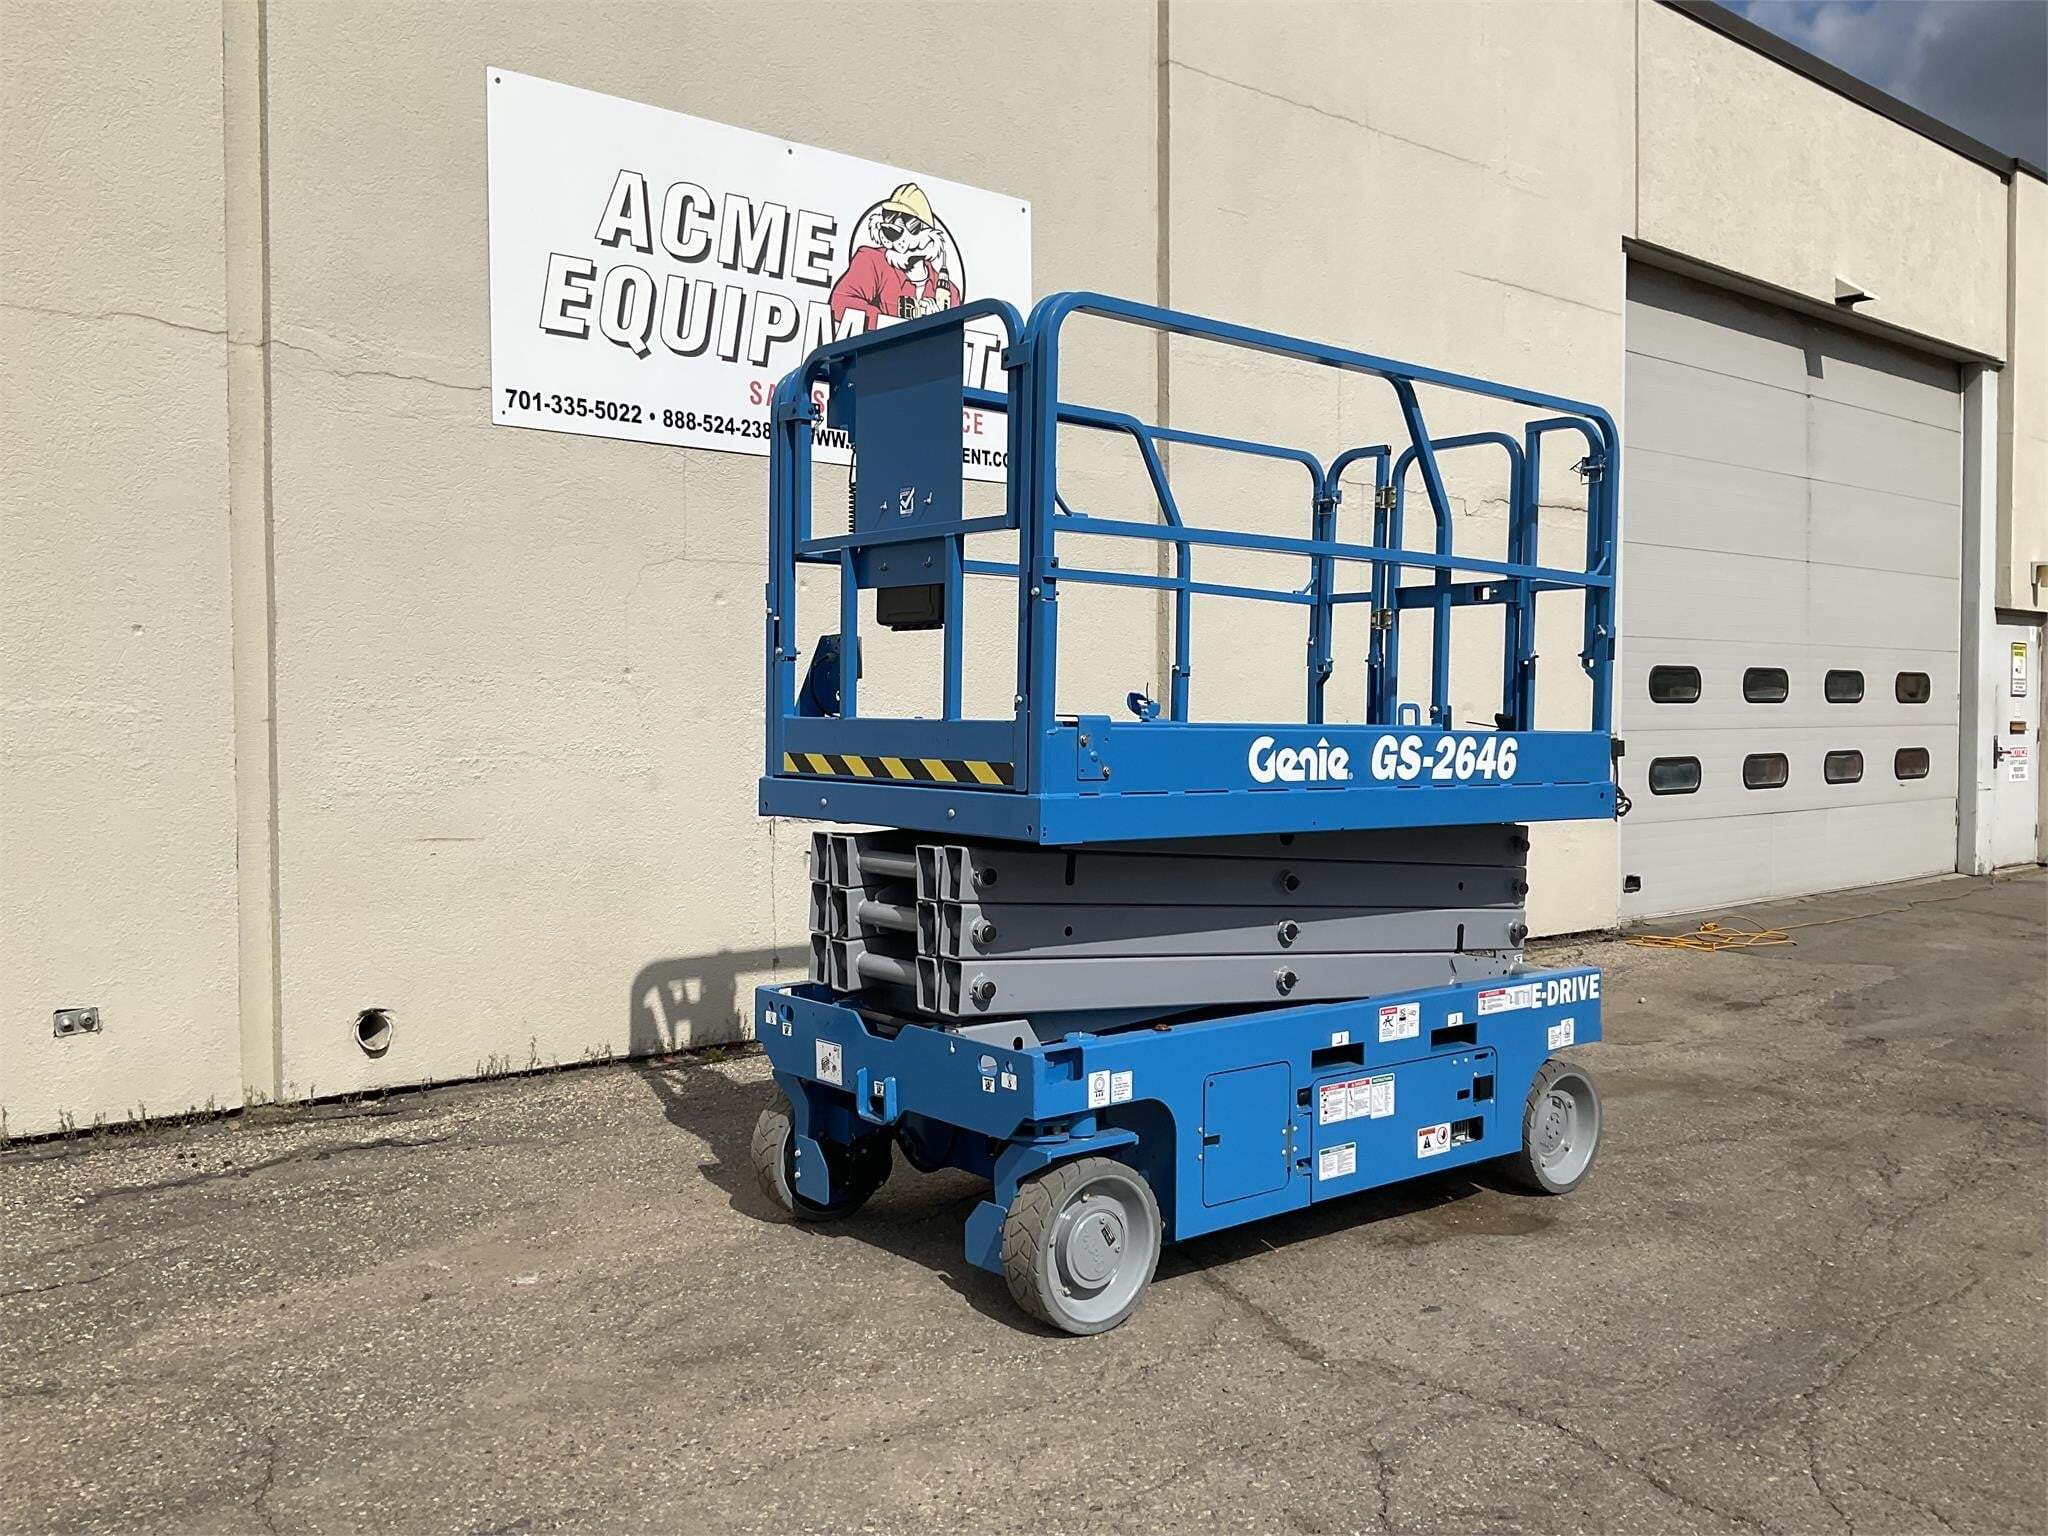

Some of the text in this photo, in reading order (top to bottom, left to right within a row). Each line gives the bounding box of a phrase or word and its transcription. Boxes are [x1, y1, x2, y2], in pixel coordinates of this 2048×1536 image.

[594, 168, 837, 289] ACME
[538, 251, 1002, 391] EQUIPMT
[504, 387, 772, 440] 701-335-5022 888-524-238
[1247, 733, 1519, 784] Genie GS-2646
[1531, 973, 1600, 1009] E-DRIVE
